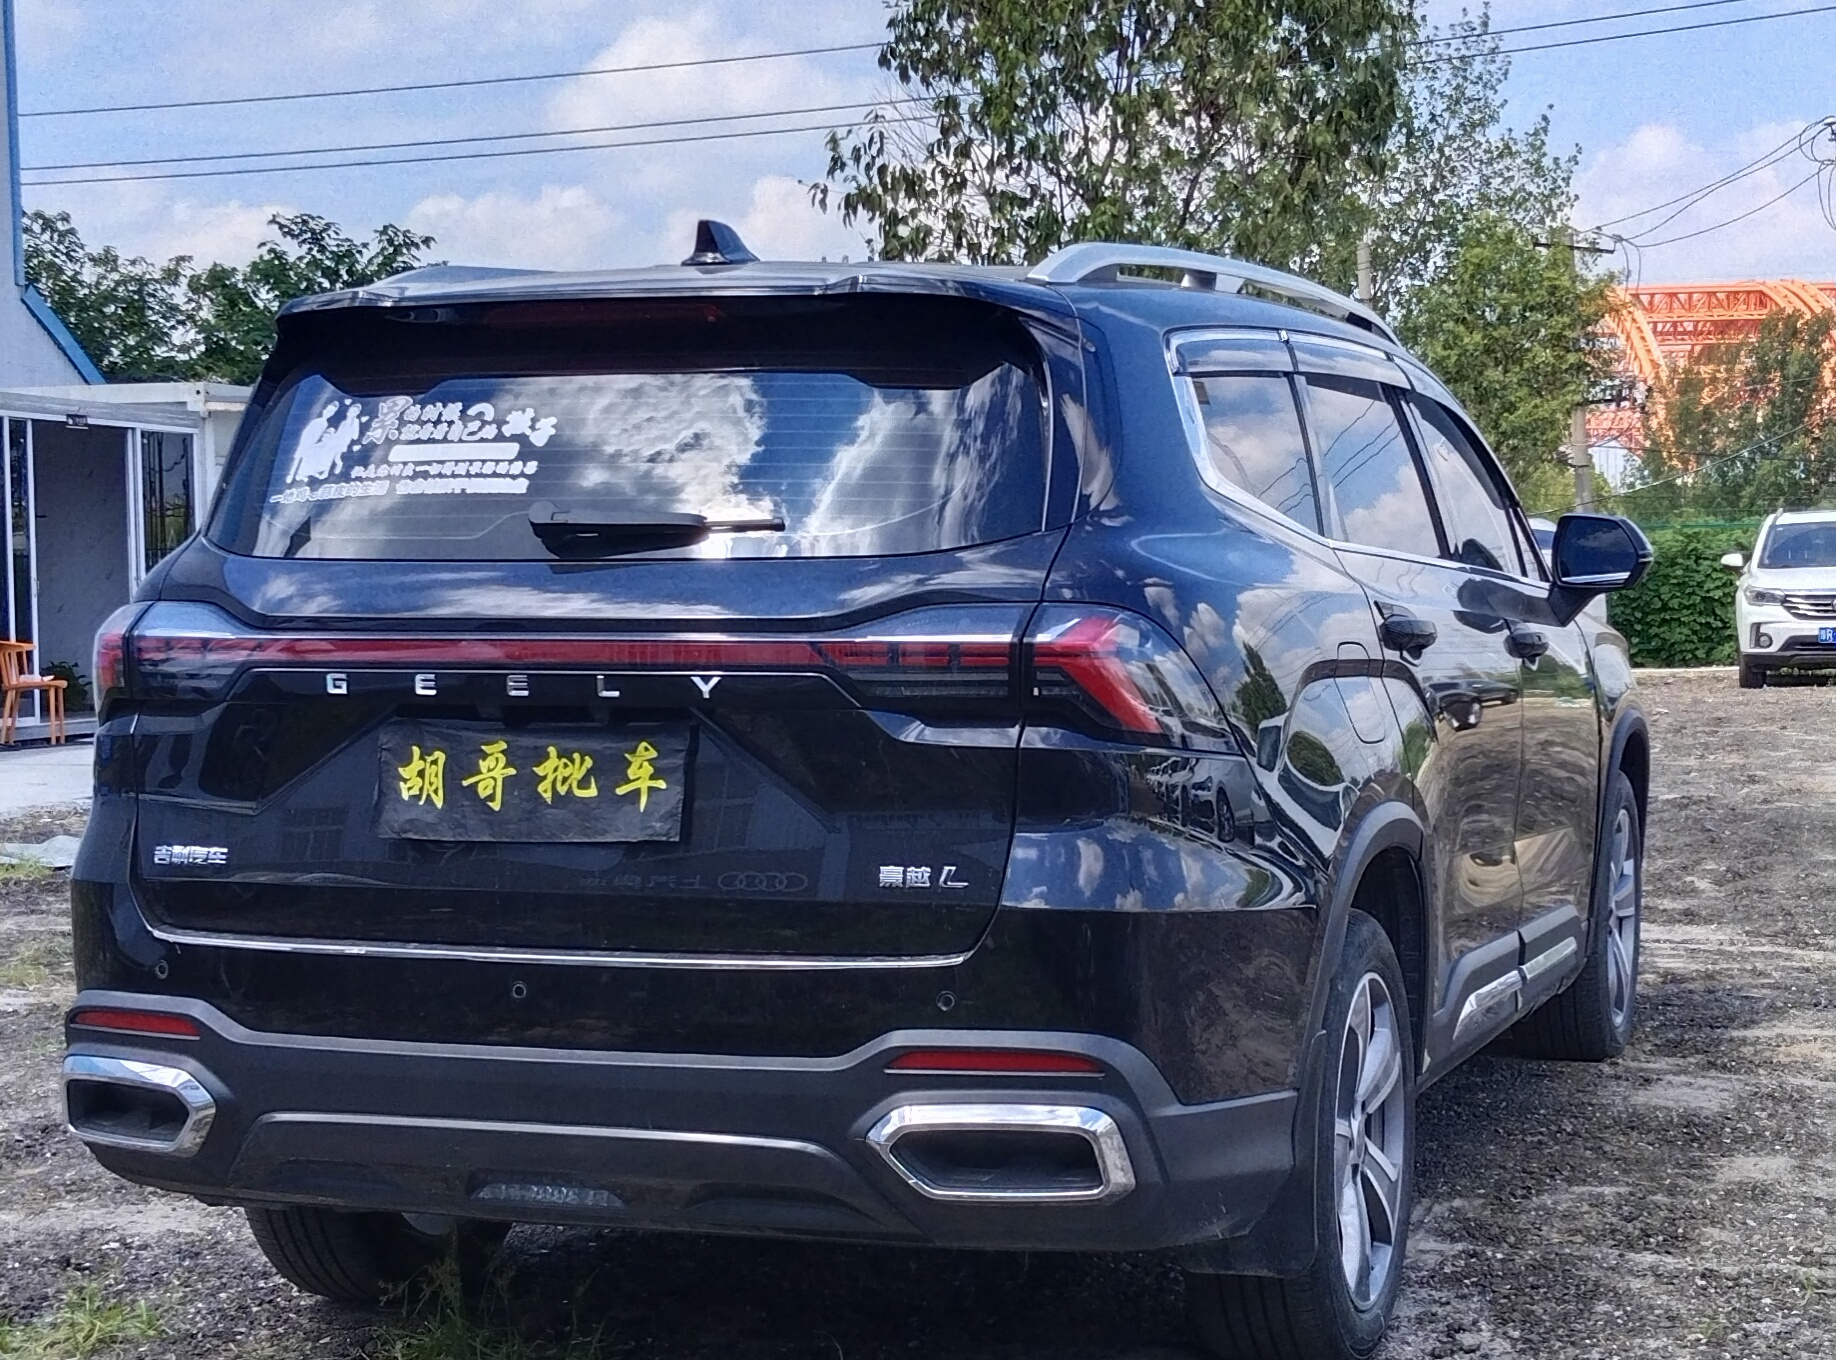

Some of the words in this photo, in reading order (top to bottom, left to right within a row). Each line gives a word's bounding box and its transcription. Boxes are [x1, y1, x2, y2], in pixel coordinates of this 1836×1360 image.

[326, 672, 721, 699] GEELY
[398, 740, 667, 813] 胡哥批车
[153, 844, 229, 865] 吉利汽车
[879, 865, 932, 888] 豪越
[938, 865, 970, 889] L
